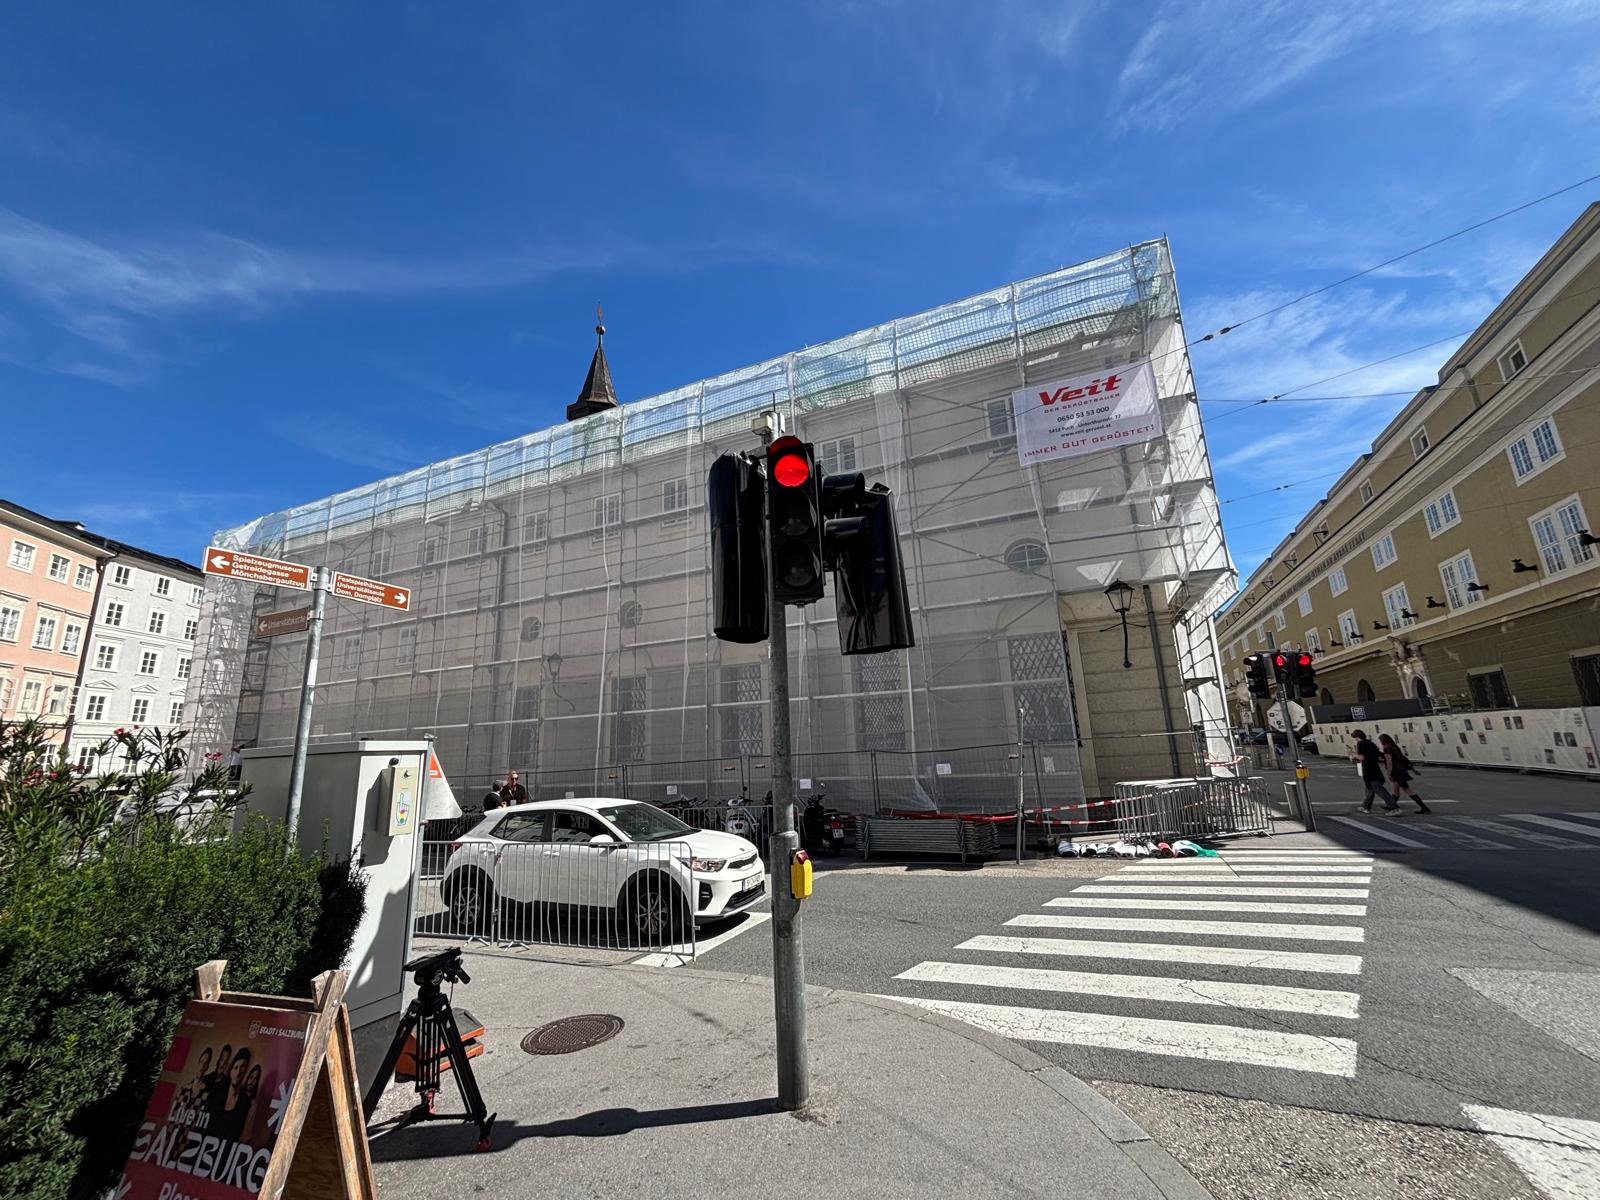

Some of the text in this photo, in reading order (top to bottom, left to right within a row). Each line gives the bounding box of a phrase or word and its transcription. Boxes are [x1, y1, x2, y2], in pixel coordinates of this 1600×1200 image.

[1039, 375, 1121, 405] Veit
[1063, 393, 1120, 409] GERÜSTBAUER
[1057, 405, 1110, 423] 0650 53 53 000
[1024, 424, 1155, 458] IMMER GUT GERÜSTET!
[231, 562, 290, 578] Getreidegasse
[232, 554, 304, 574] Spielzeugmuseum
[230, 568, 305, 588] Mönchsbergaufzug
[337, 575, 385, 591] Festspielhäuser
[336, 581, 385, 597] Universitätsaula
[336, 587, 383, 603] Dom, Domplatz
[259, 1025, 305, 1040] STADT SALZBURG
[168, 1101, 211, 1129] Live in
[129, 1121, 271, 1194] SALZBURG
